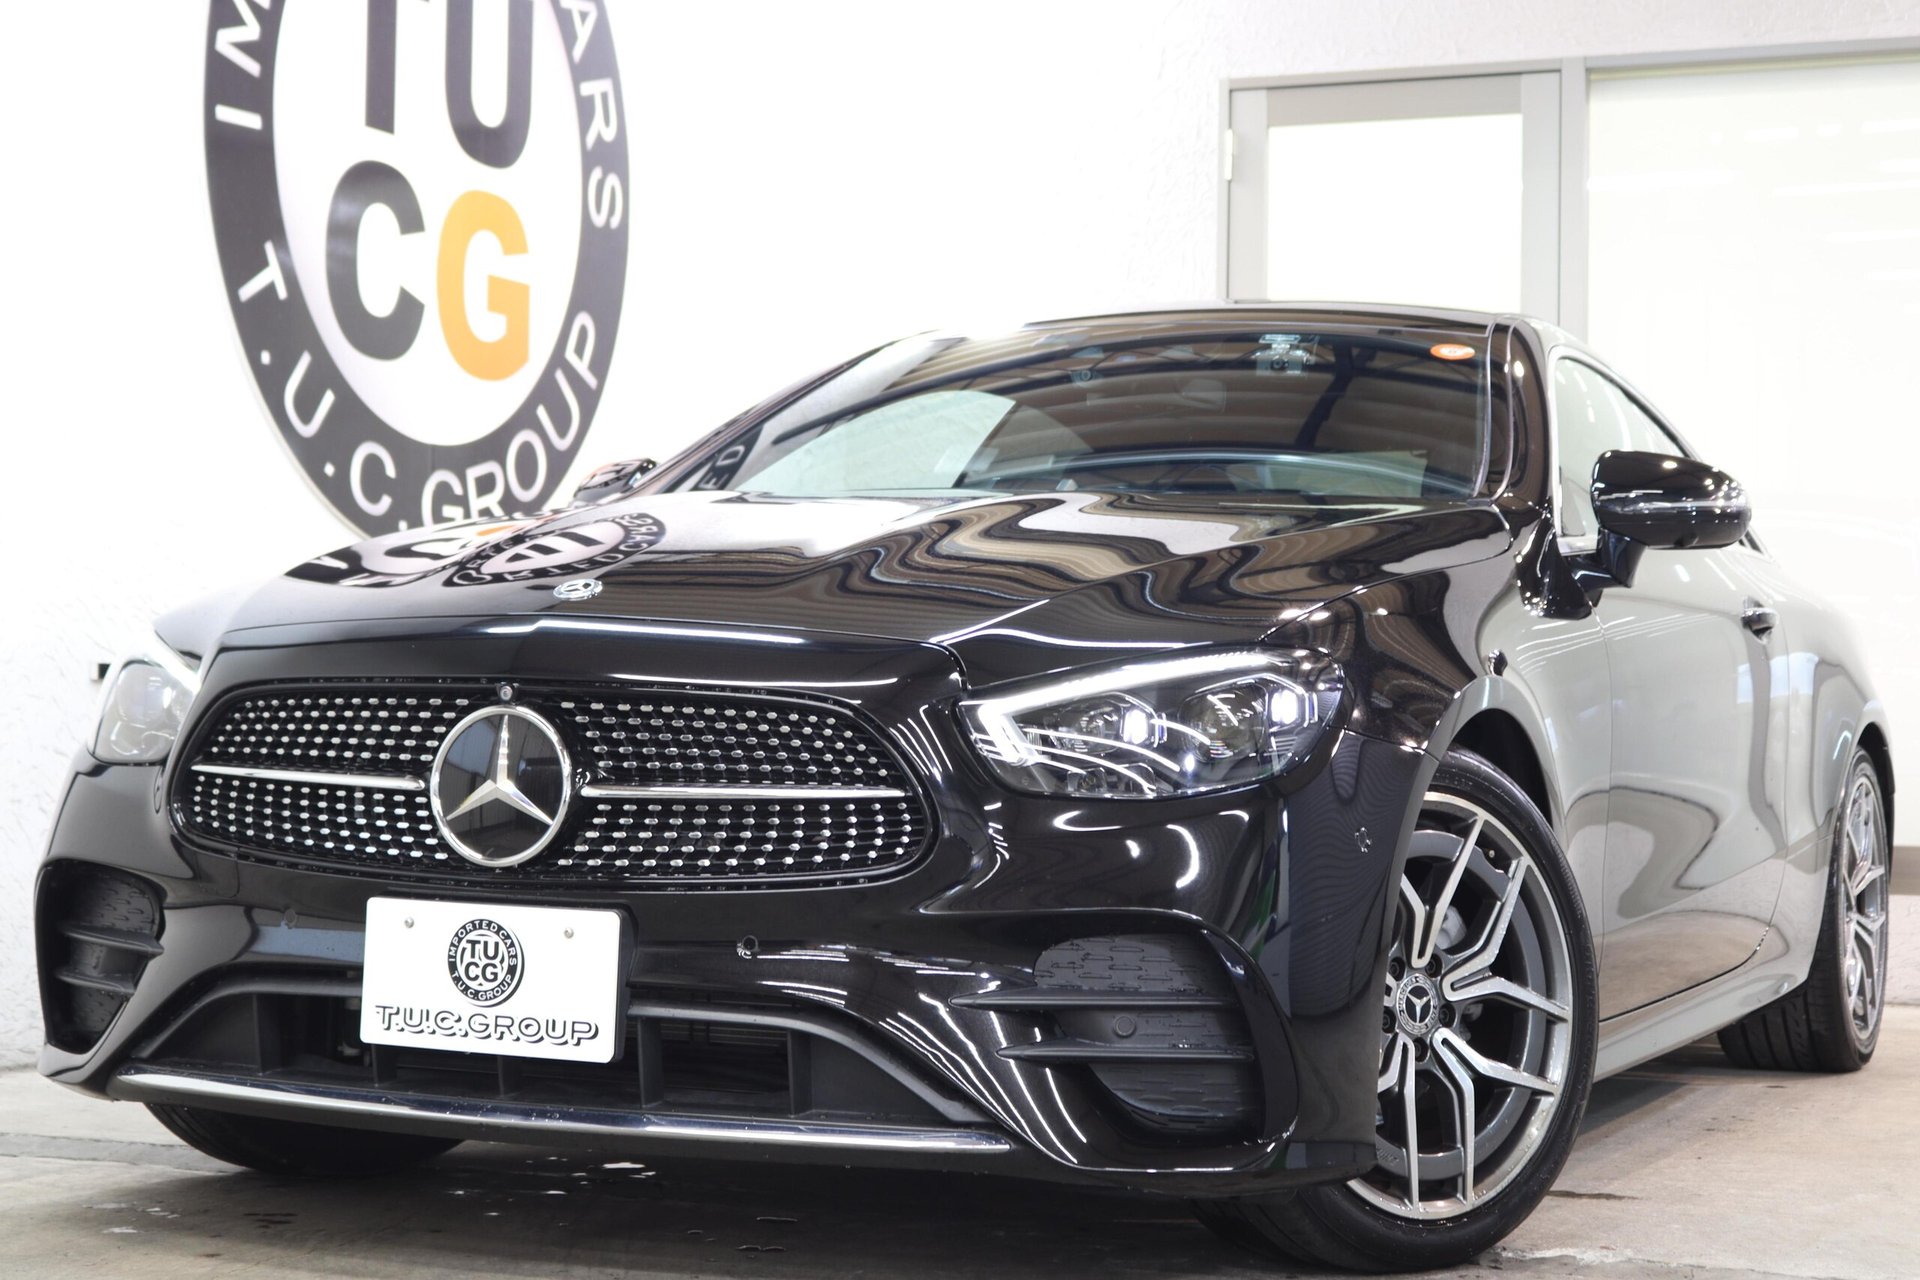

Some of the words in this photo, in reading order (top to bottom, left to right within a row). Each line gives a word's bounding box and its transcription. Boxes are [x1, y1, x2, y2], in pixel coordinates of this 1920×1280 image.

[325, 160, 530, 381] CG
[448, 920, 498, 962] IMPORTED
[499, 930, 517, 966] CARS
